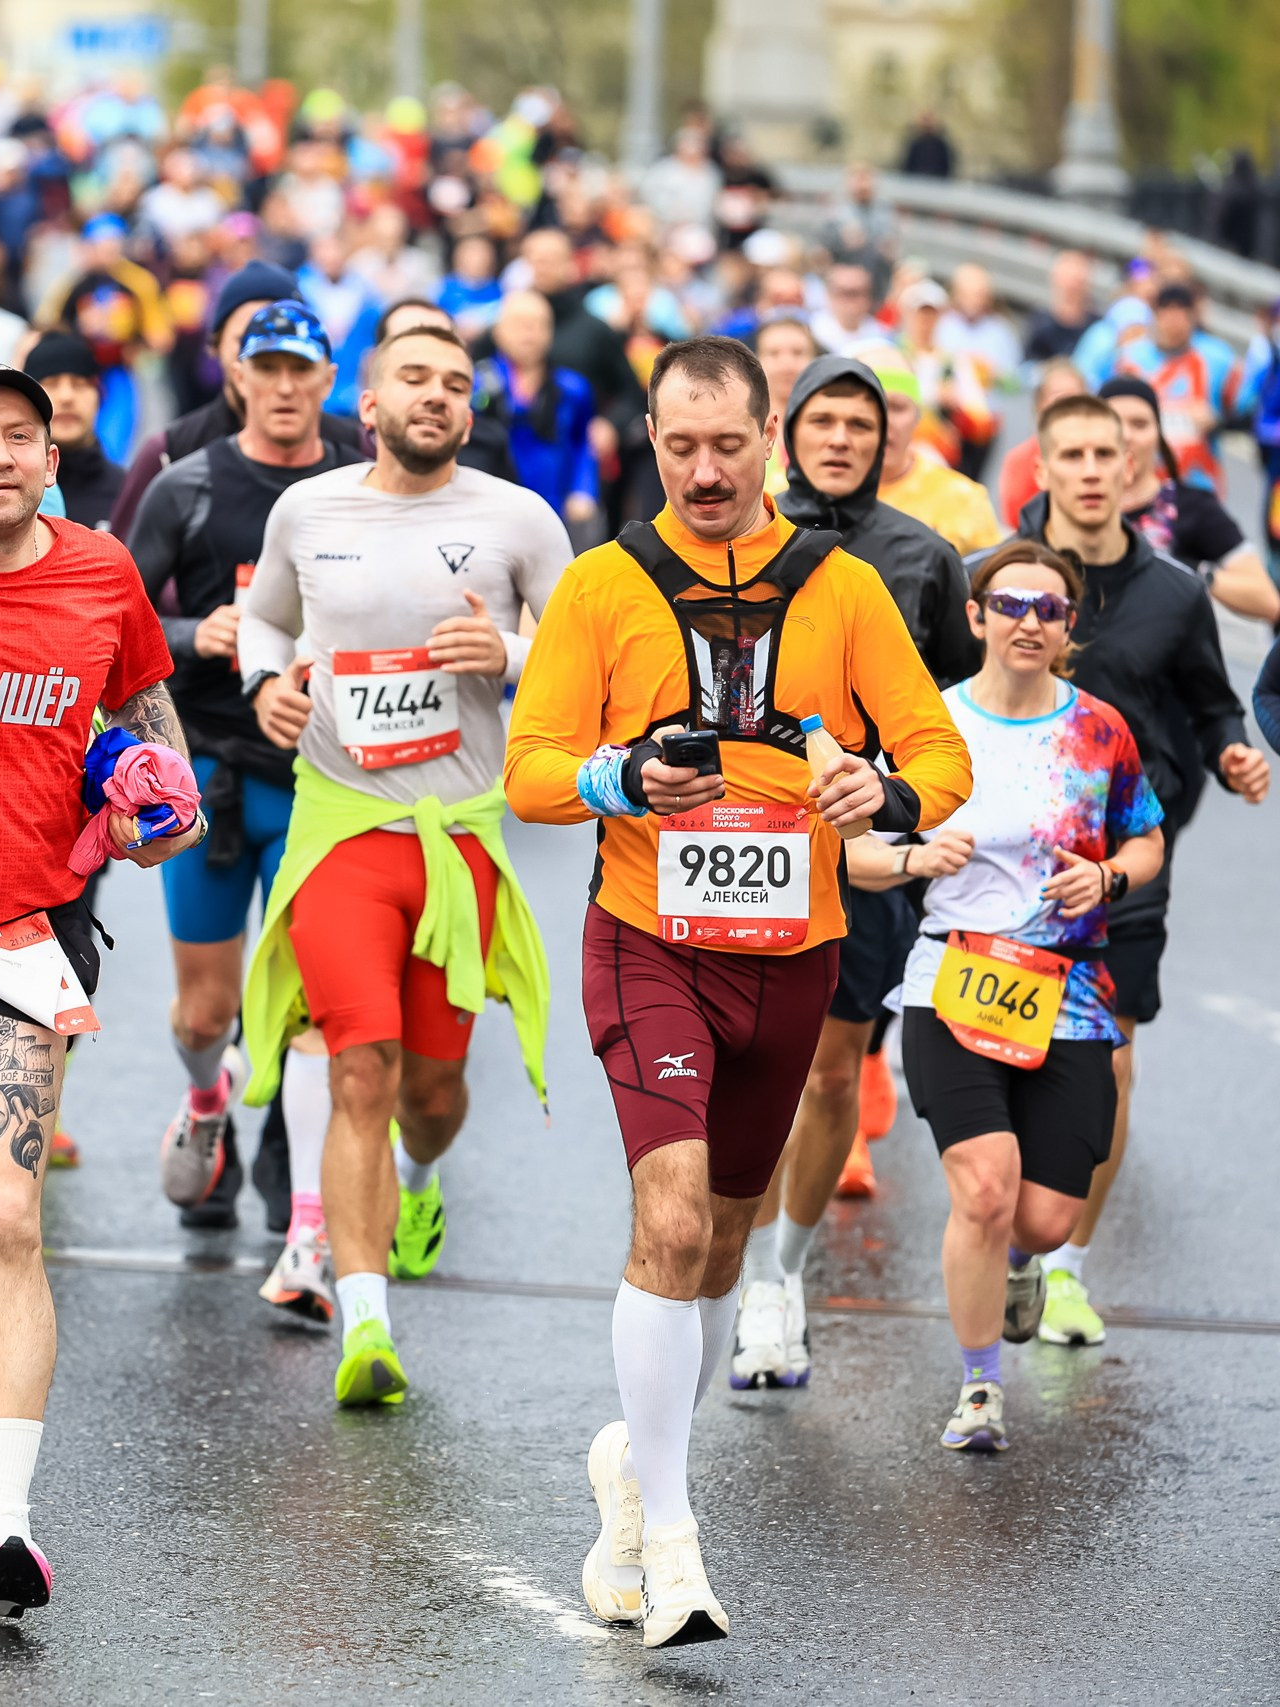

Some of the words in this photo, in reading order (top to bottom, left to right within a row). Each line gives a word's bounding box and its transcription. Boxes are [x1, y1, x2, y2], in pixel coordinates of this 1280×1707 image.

[350, 680, 442, 721] 7444
[712, 806, 764, 815] МОСКОВСКИЙ
[679, 844, 791, 888] 9820
[702, 889, 769, 903] АЛЕКСЕЙ
[671, 917, 690, 940] D
[959, 967, 1040, 1021] 1046
